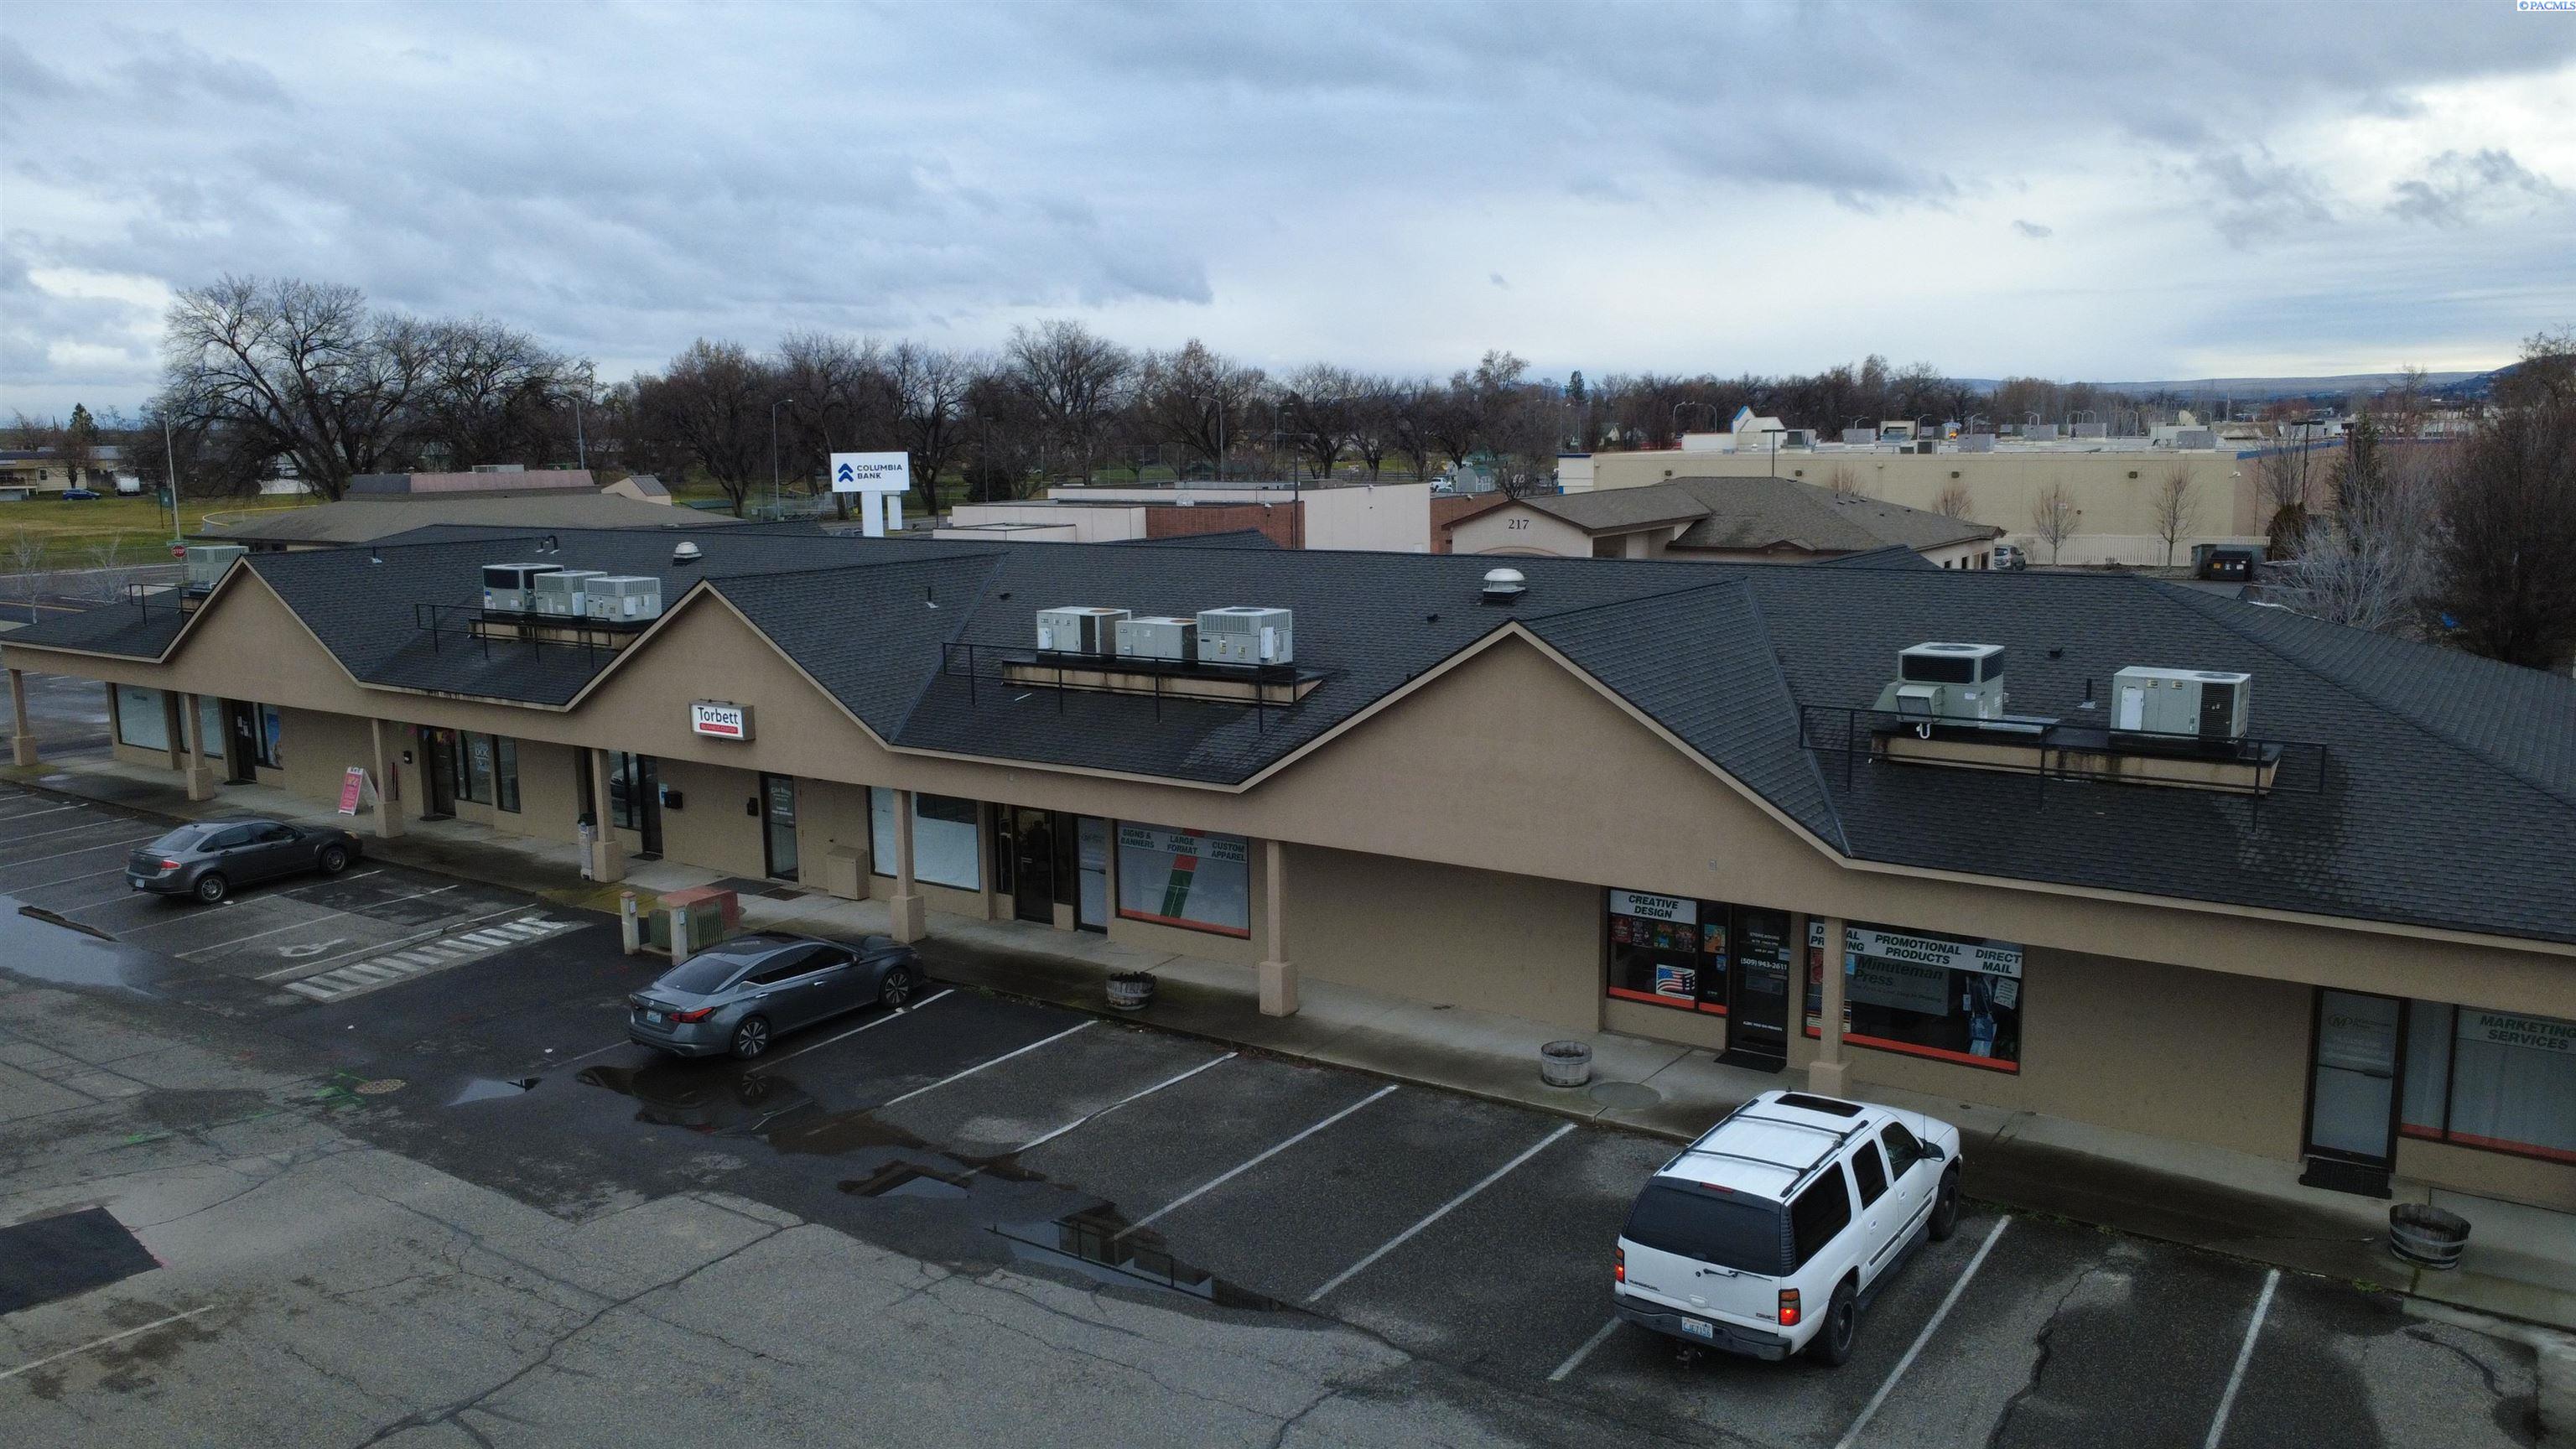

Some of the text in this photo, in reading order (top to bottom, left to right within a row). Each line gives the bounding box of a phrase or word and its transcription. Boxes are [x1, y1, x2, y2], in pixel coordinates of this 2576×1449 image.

[1509, 519, 1529, 529] 217
[698, 707, 738, 724] Torbett
[1123, 828, 1145, 839] SIGNS
[1170, 834, 1194, 845] LARGE
[1120, 837, 1155, 849] BANNERS
[1167, 844, 1197, 854] FORMAT
[1211, 841, 1244, 853] CUSTOM
[1211, 850, 1245, 861] APPAREL
[1628, 895, 1679, 909] CREATIVE
[1634, 905, 1672, 919] DESIGN
[1874, 934, 1961, 955] PROMOTIONAL
[1885, 947, 1950, 965] PRODUCTS
[1975, 948, 2021, 964] DIRECT
[1740, 957, 1788, 970] (509) 943-2611
[1857, 956, 1943, 980] Minuteman
[1981, 962, 2012, 974] MAIL
[1853, 969, 1894, 987] Press
[2480, 1015, 2576, 1039] MARKETING
[2488, 1029, 2569, 1050] SERVICES
